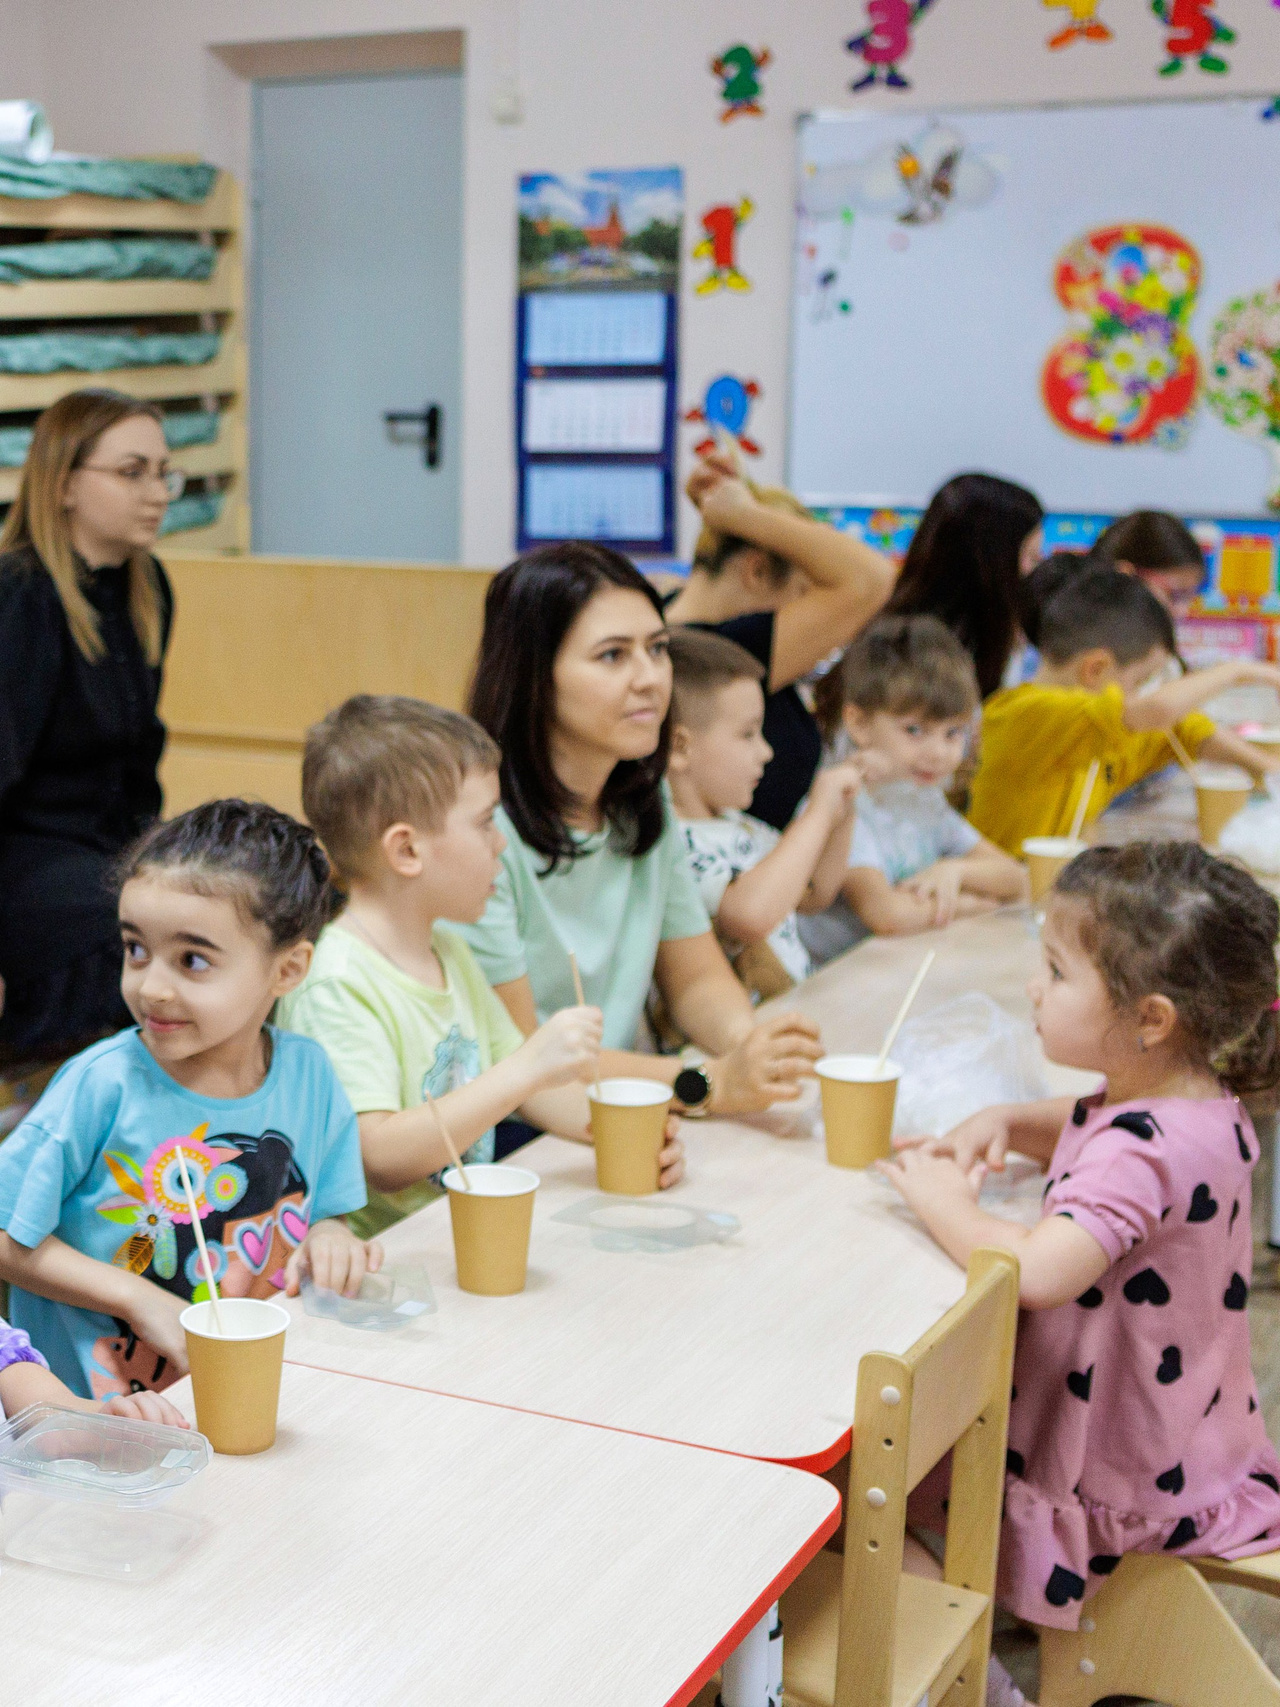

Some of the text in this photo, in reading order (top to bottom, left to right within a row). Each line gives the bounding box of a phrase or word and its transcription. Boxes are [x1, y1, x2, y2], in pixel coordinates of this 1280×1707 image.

[864, 0, 910, 63] 3
[1167, 0, 1213, 55] 5
[722, 46, 759, 100] 2
[703, 206, 735, 268] 1
[1041, 222, 1202, 444] 8
